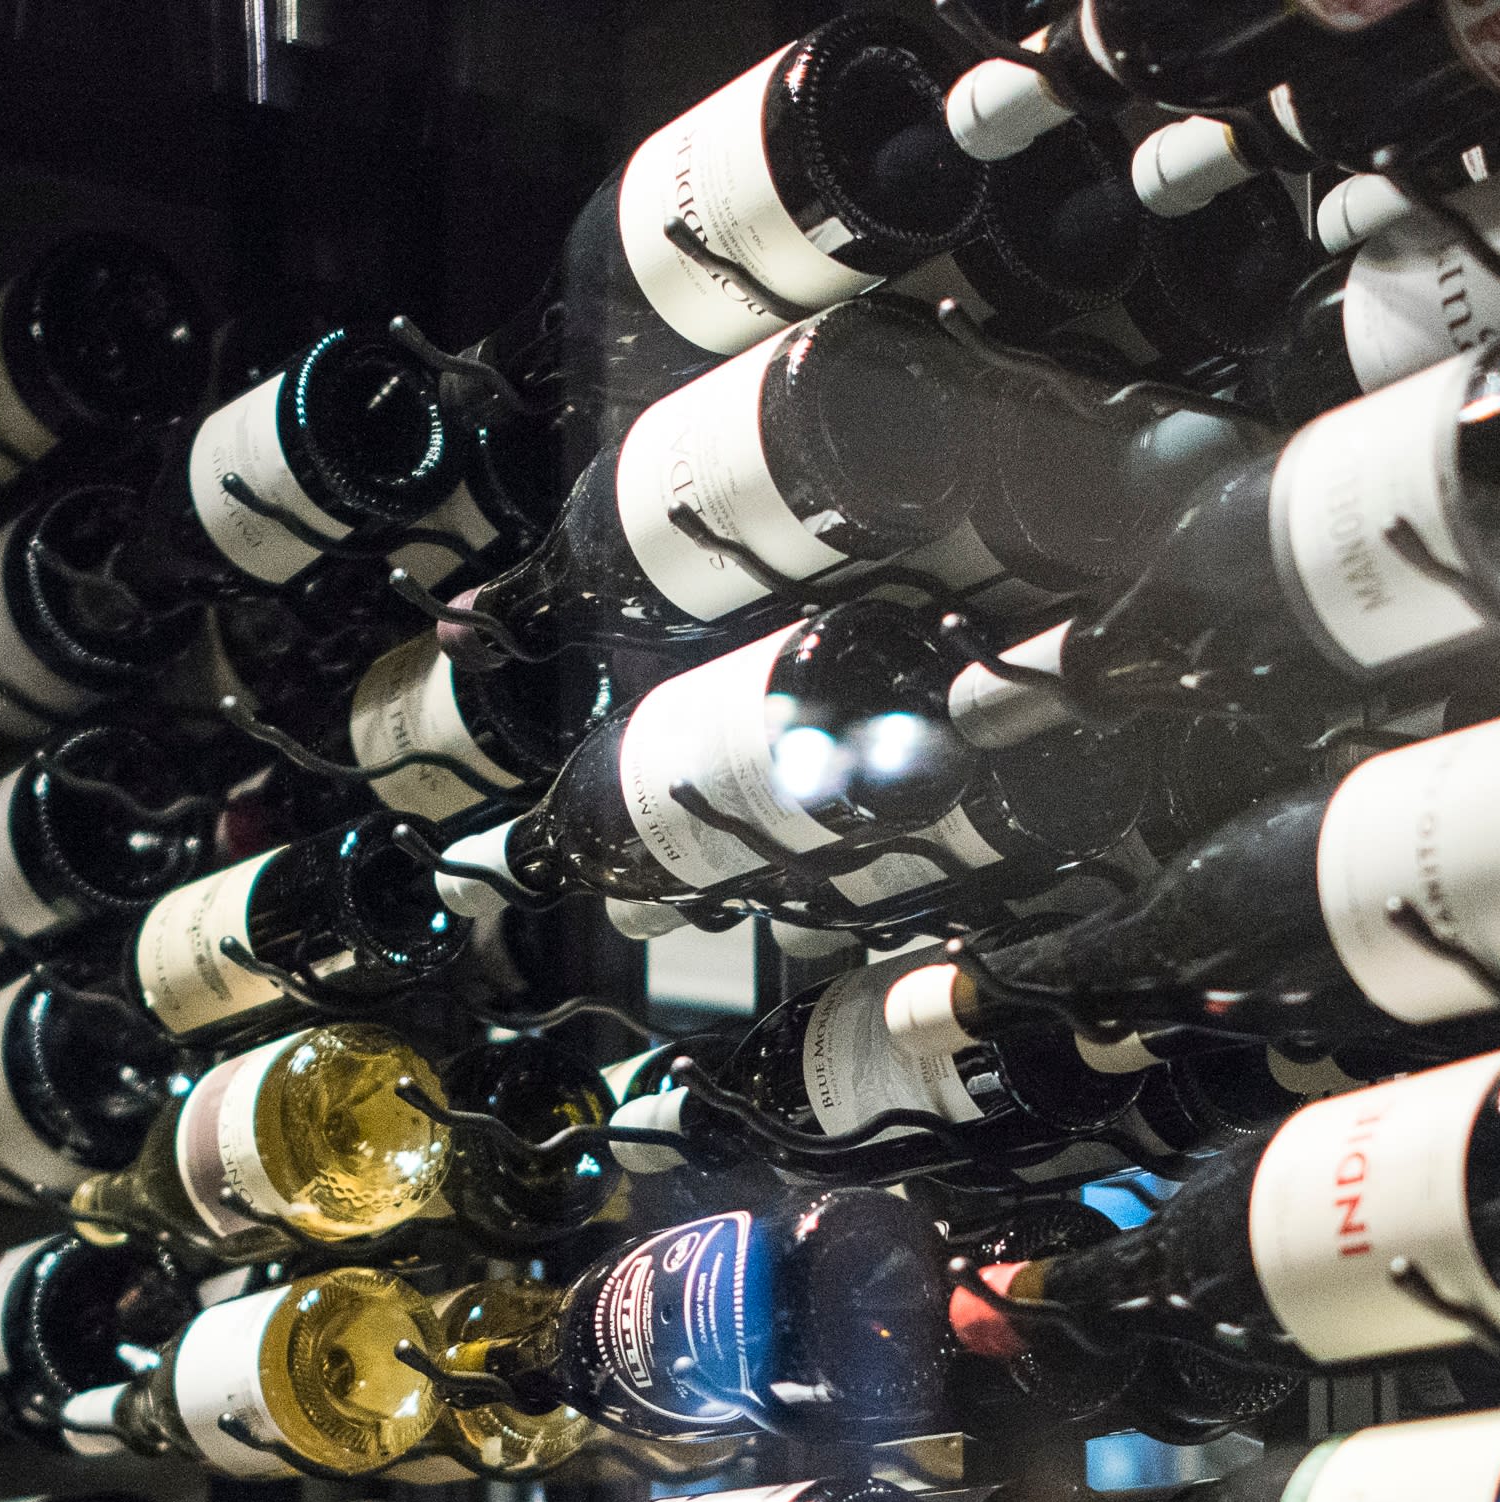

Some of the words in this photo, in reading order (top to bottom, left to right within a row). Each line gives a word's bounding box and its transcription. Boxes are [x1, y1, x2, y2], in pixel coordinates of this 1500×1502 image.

[649, 820, 682, 862] BLUE
[815, 1063, 835, 1109] BLUE
[221, 1122, 255, 1206] ONKEY
[696, 1272, 708, 1302] NOIR
[608, 1290, 619, 1336] CALIFORNIA
[695, 1303, 708, 1344] GAMAY
